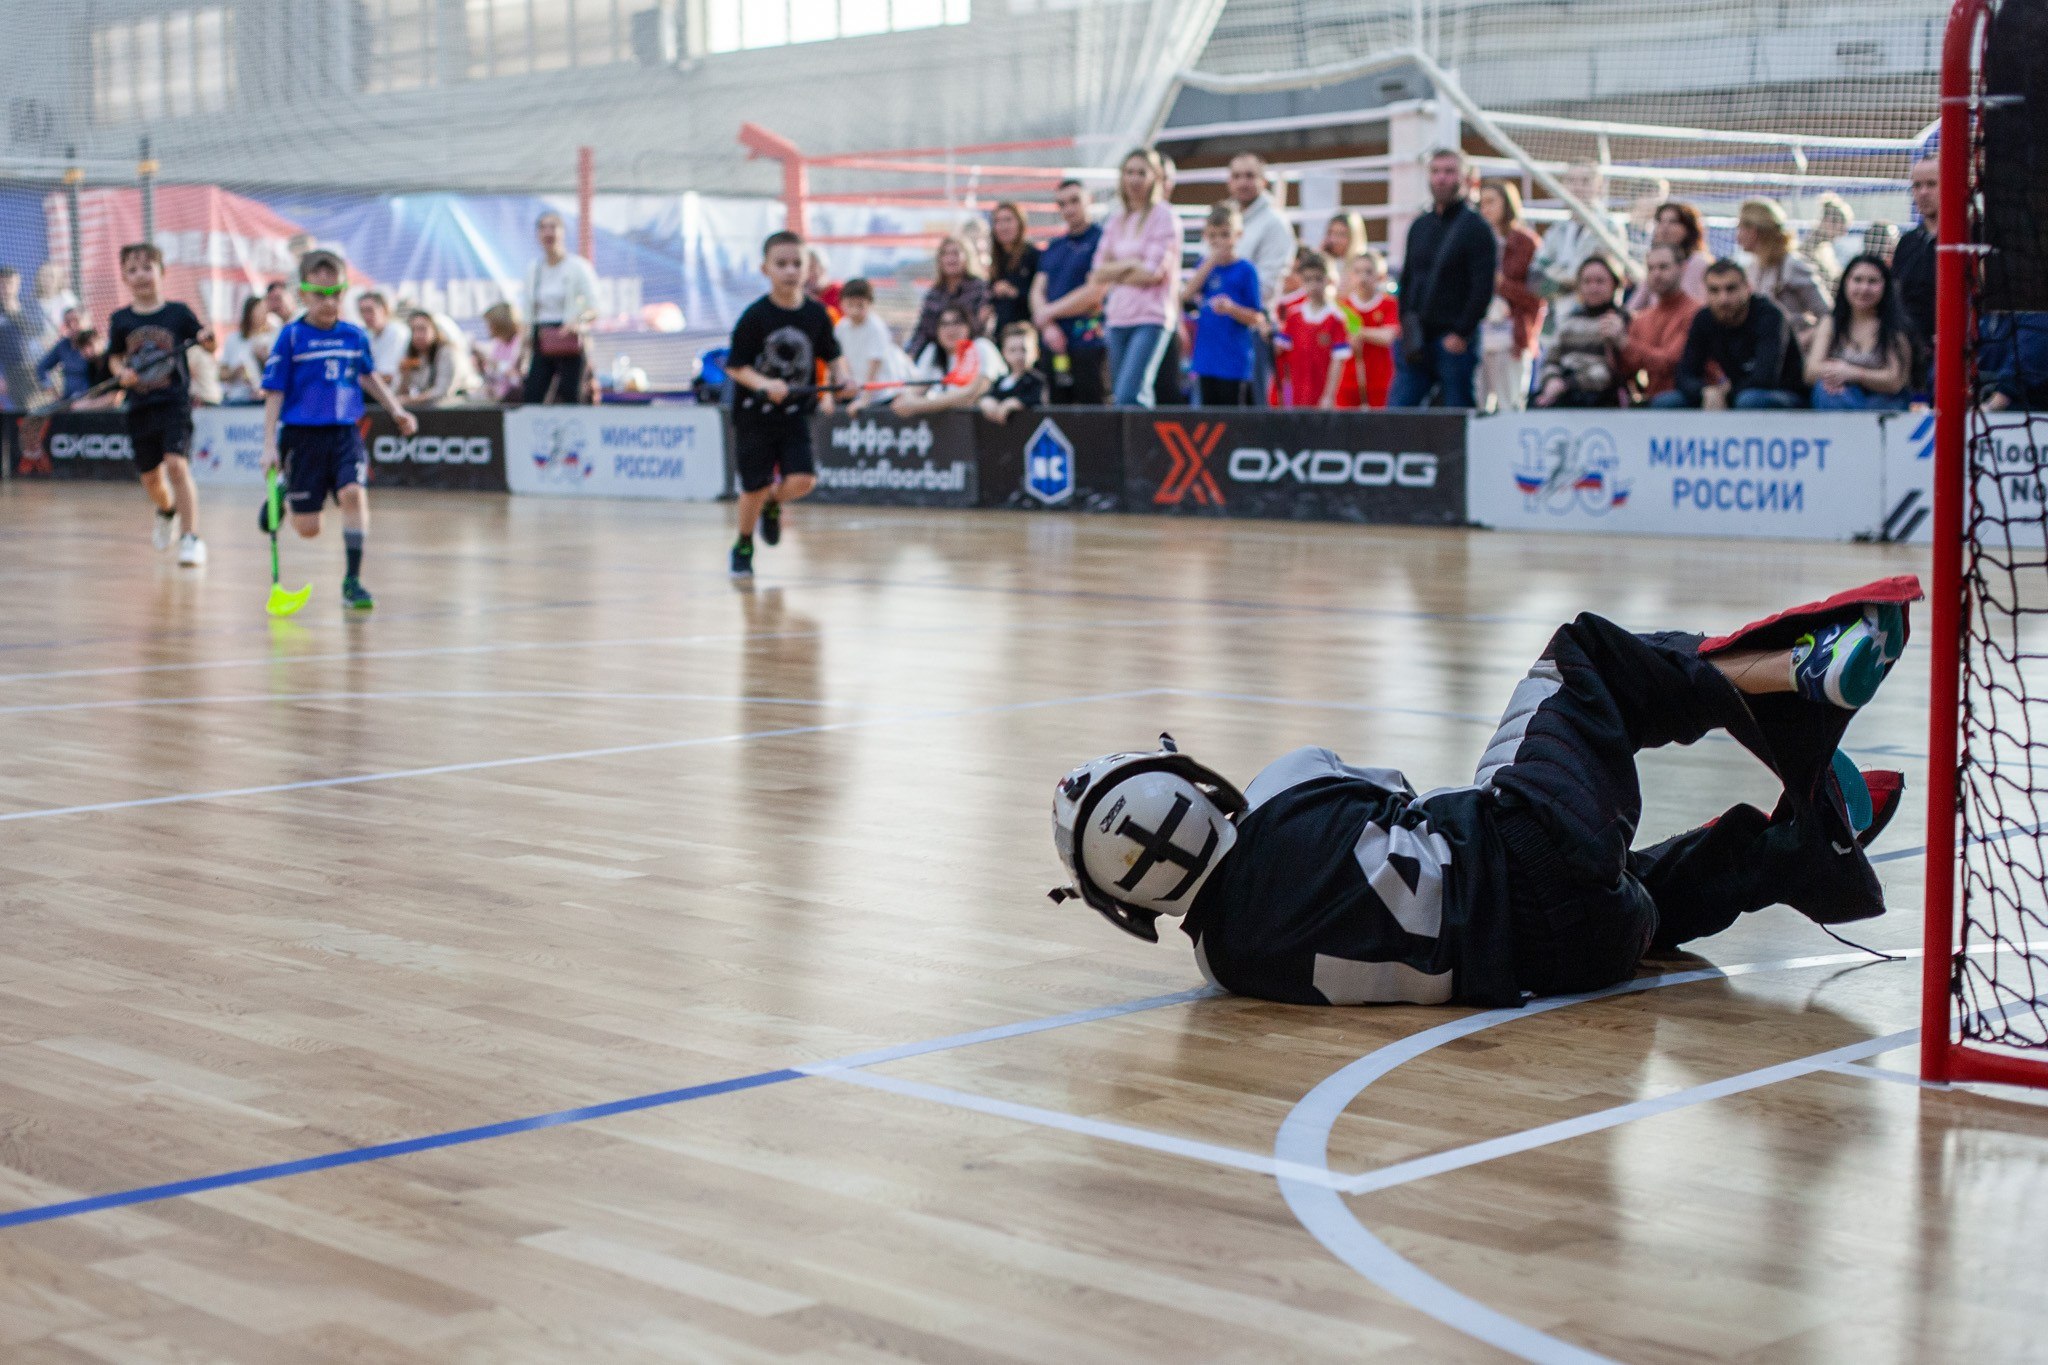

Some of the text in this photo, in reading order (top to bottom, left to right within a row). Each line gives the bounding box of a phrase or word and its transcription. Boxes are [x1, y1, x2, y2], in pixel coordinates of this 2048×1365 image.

[374, 436, 492, 464] OXDOG
[601, 425, 695, 448] МИНСПОРТ
[614, 454, 685, 479] РОССИИ
[1228, 448, 1438, 487] OXDOG
[1648, 436, 1831, 471] МИНСПОРТ
[1672, 477, 1804, 513] РОССИИ
